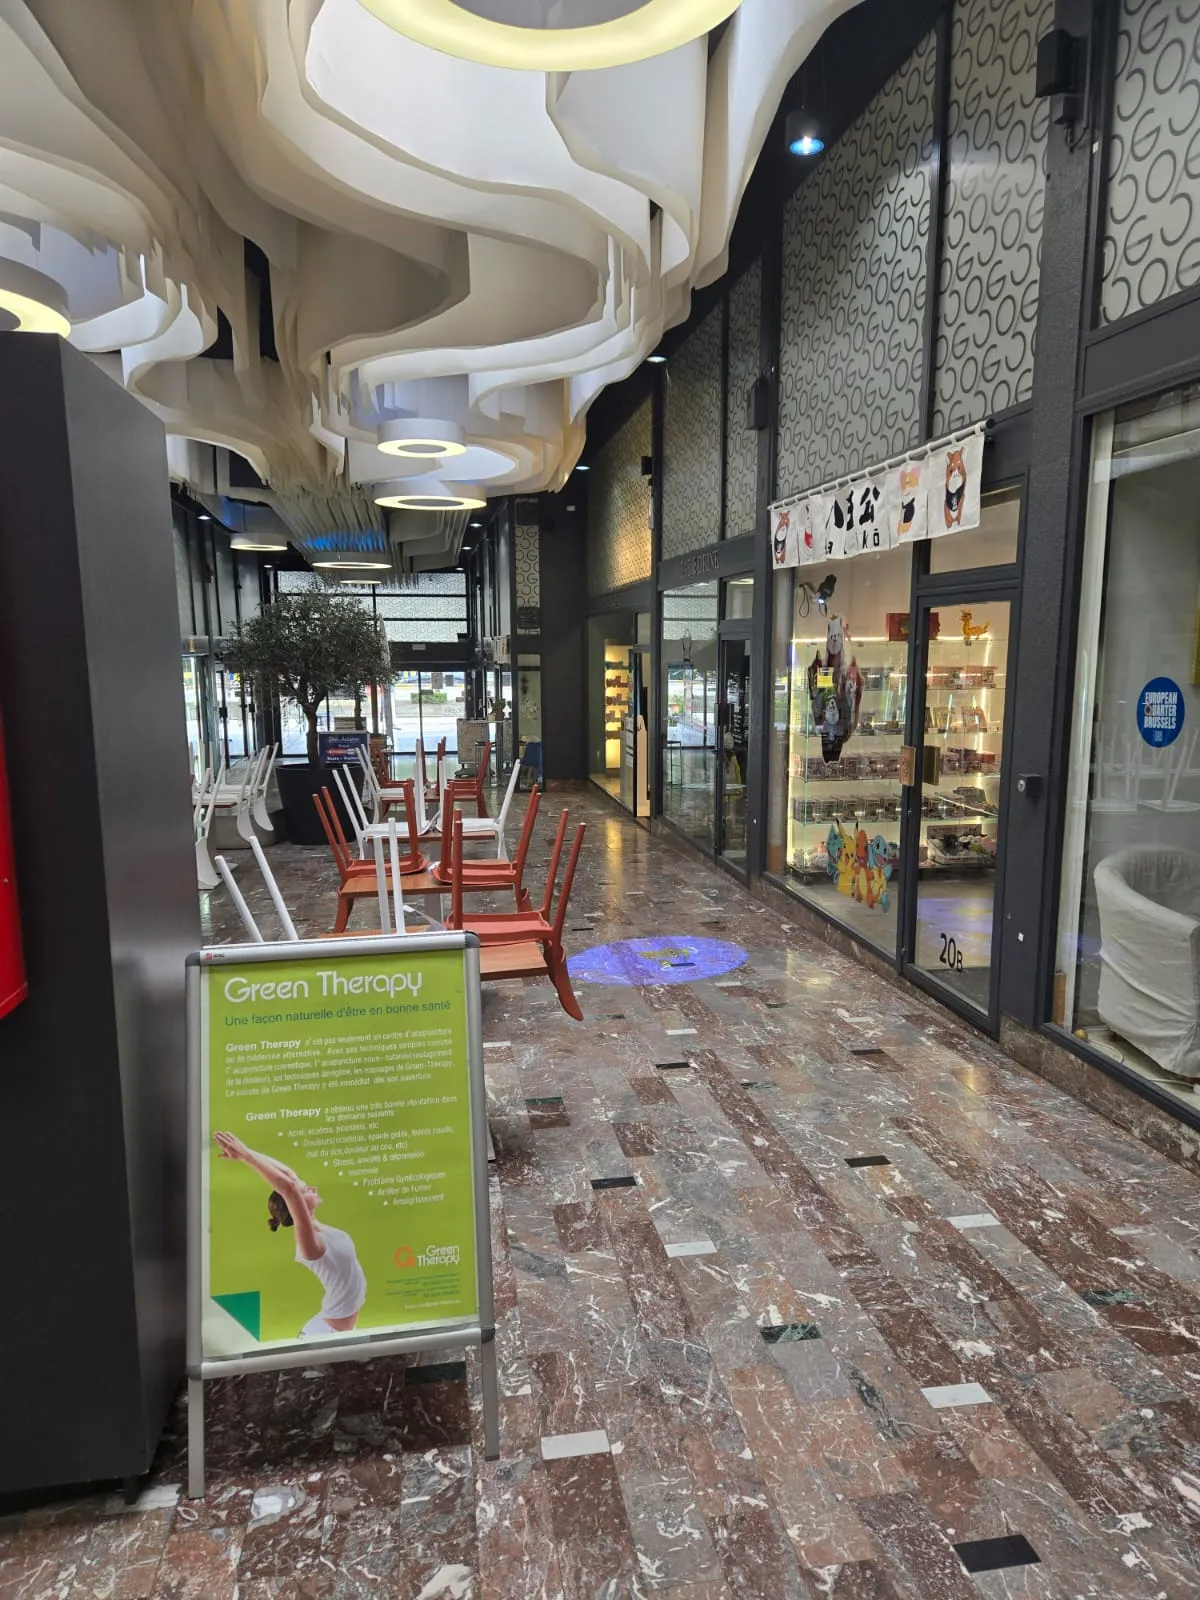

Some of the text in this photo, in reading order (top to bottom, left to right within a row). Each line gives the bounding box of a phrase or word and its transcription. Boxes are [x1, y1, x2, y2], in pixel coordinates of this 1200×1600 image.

[1144, 691, 1178, 705] EUROPEAN
[1143, 704, 1177, 717] QUARTER
[1143, 716, 1177, 730] BRUSSELS
[939, 932, 964, 972] 20B
[224, 971, 423, 1003] Green Therapy
[225, 999, 451, 1026] Une façon naturelle d'être en bonne santé
[226, 1043, 257, 1053] Green
[260, 1039, 301, 1050] Therapy
[225, 1089, 235, 1097] Le
[271, 1085, 291, 1094] Green
[294, 1082, 320, 1092] Therapy
[246, 1110, 276, 1122] Green
[280, 1107, 321, 1118] Therapy
[426, 1245, 460, 1257] Green
[416, 1254, 460, 1268] Therapy
